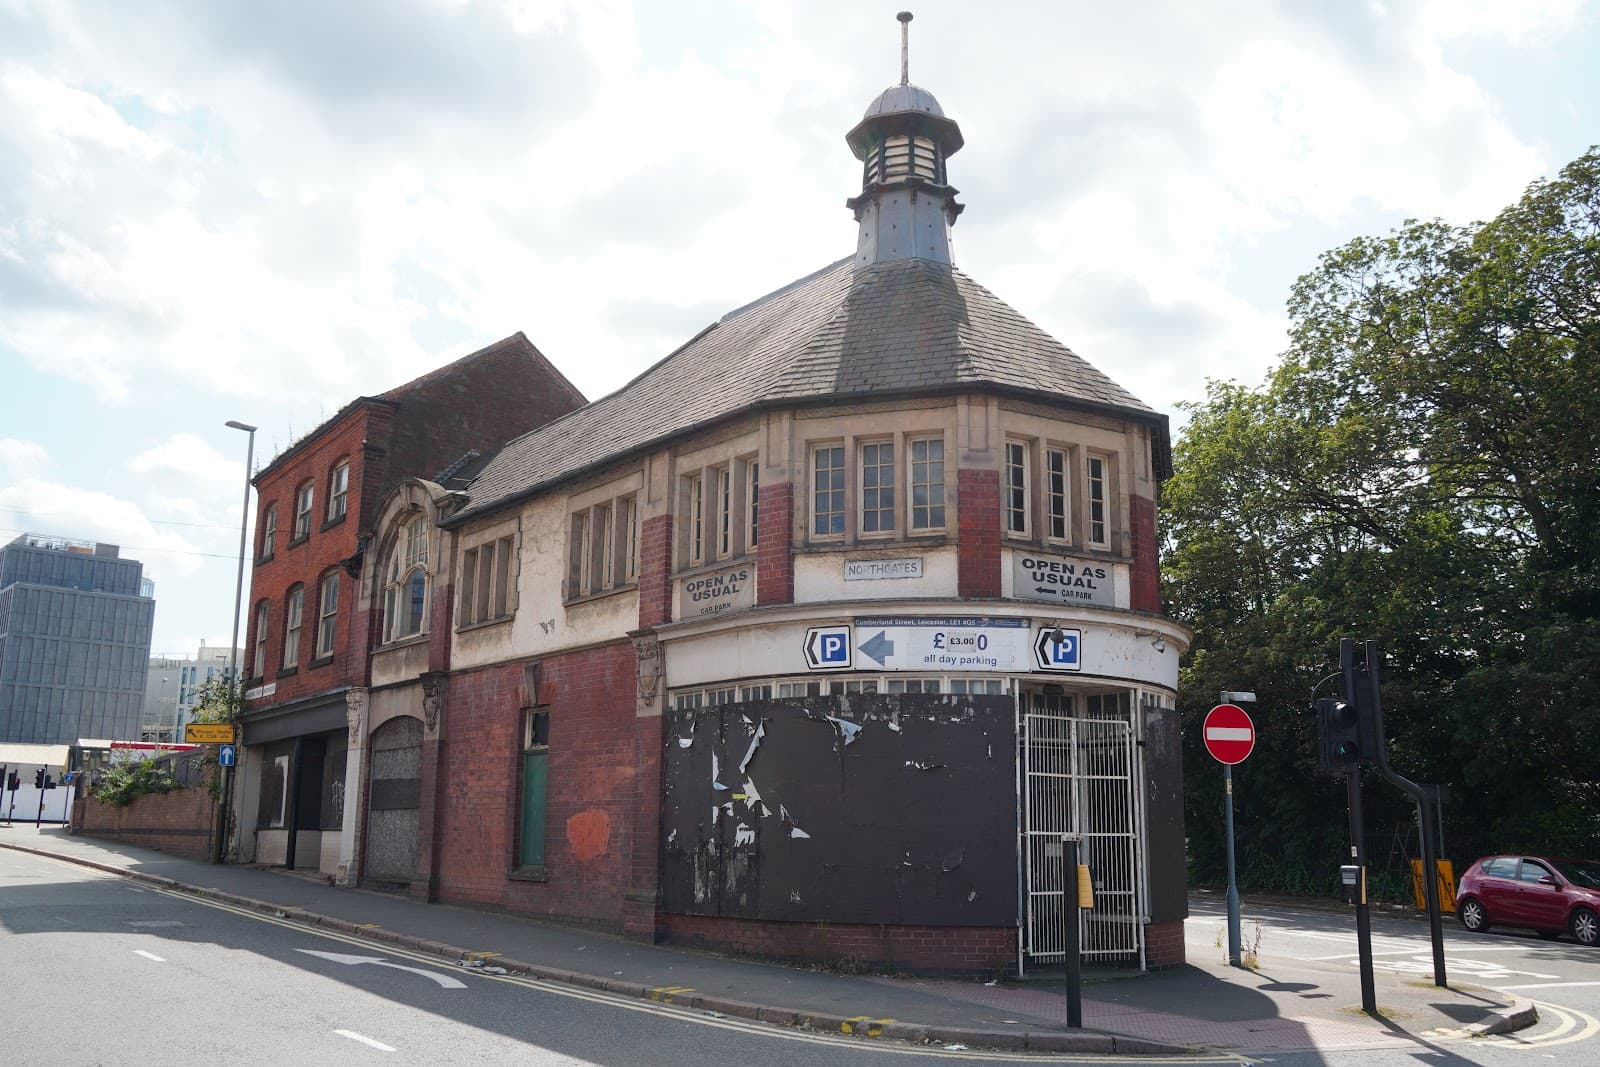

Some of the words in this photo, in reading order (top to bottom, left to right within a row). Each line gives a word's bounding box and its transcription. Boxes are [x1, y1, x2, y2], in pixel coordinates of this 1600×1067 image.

[1021, 558, 1075, 575] OPEN
[1082, 566, 1106, 579] AS
[686, 575, 724, 593] OPEN
[729, 570, 748, 584] AS
[1032, 571, 1097, 590] USUAL
[693, 583, 740, 602] USUAL
[1061, 589, 1074, 598] CAR
[1075, 591, 1092, 600] PARK
[700, 606, 713, 615] CAR
[714, 602, 732, 613] PARK
[826, 637, 841, 659] P
[950, 637, 974, 646] £3.00
[1058, 638, 1073, 660] P
[924, 654, 936, 663] all
[938, 654, 957, 666] day
[960, 655, 997, 667] parking
